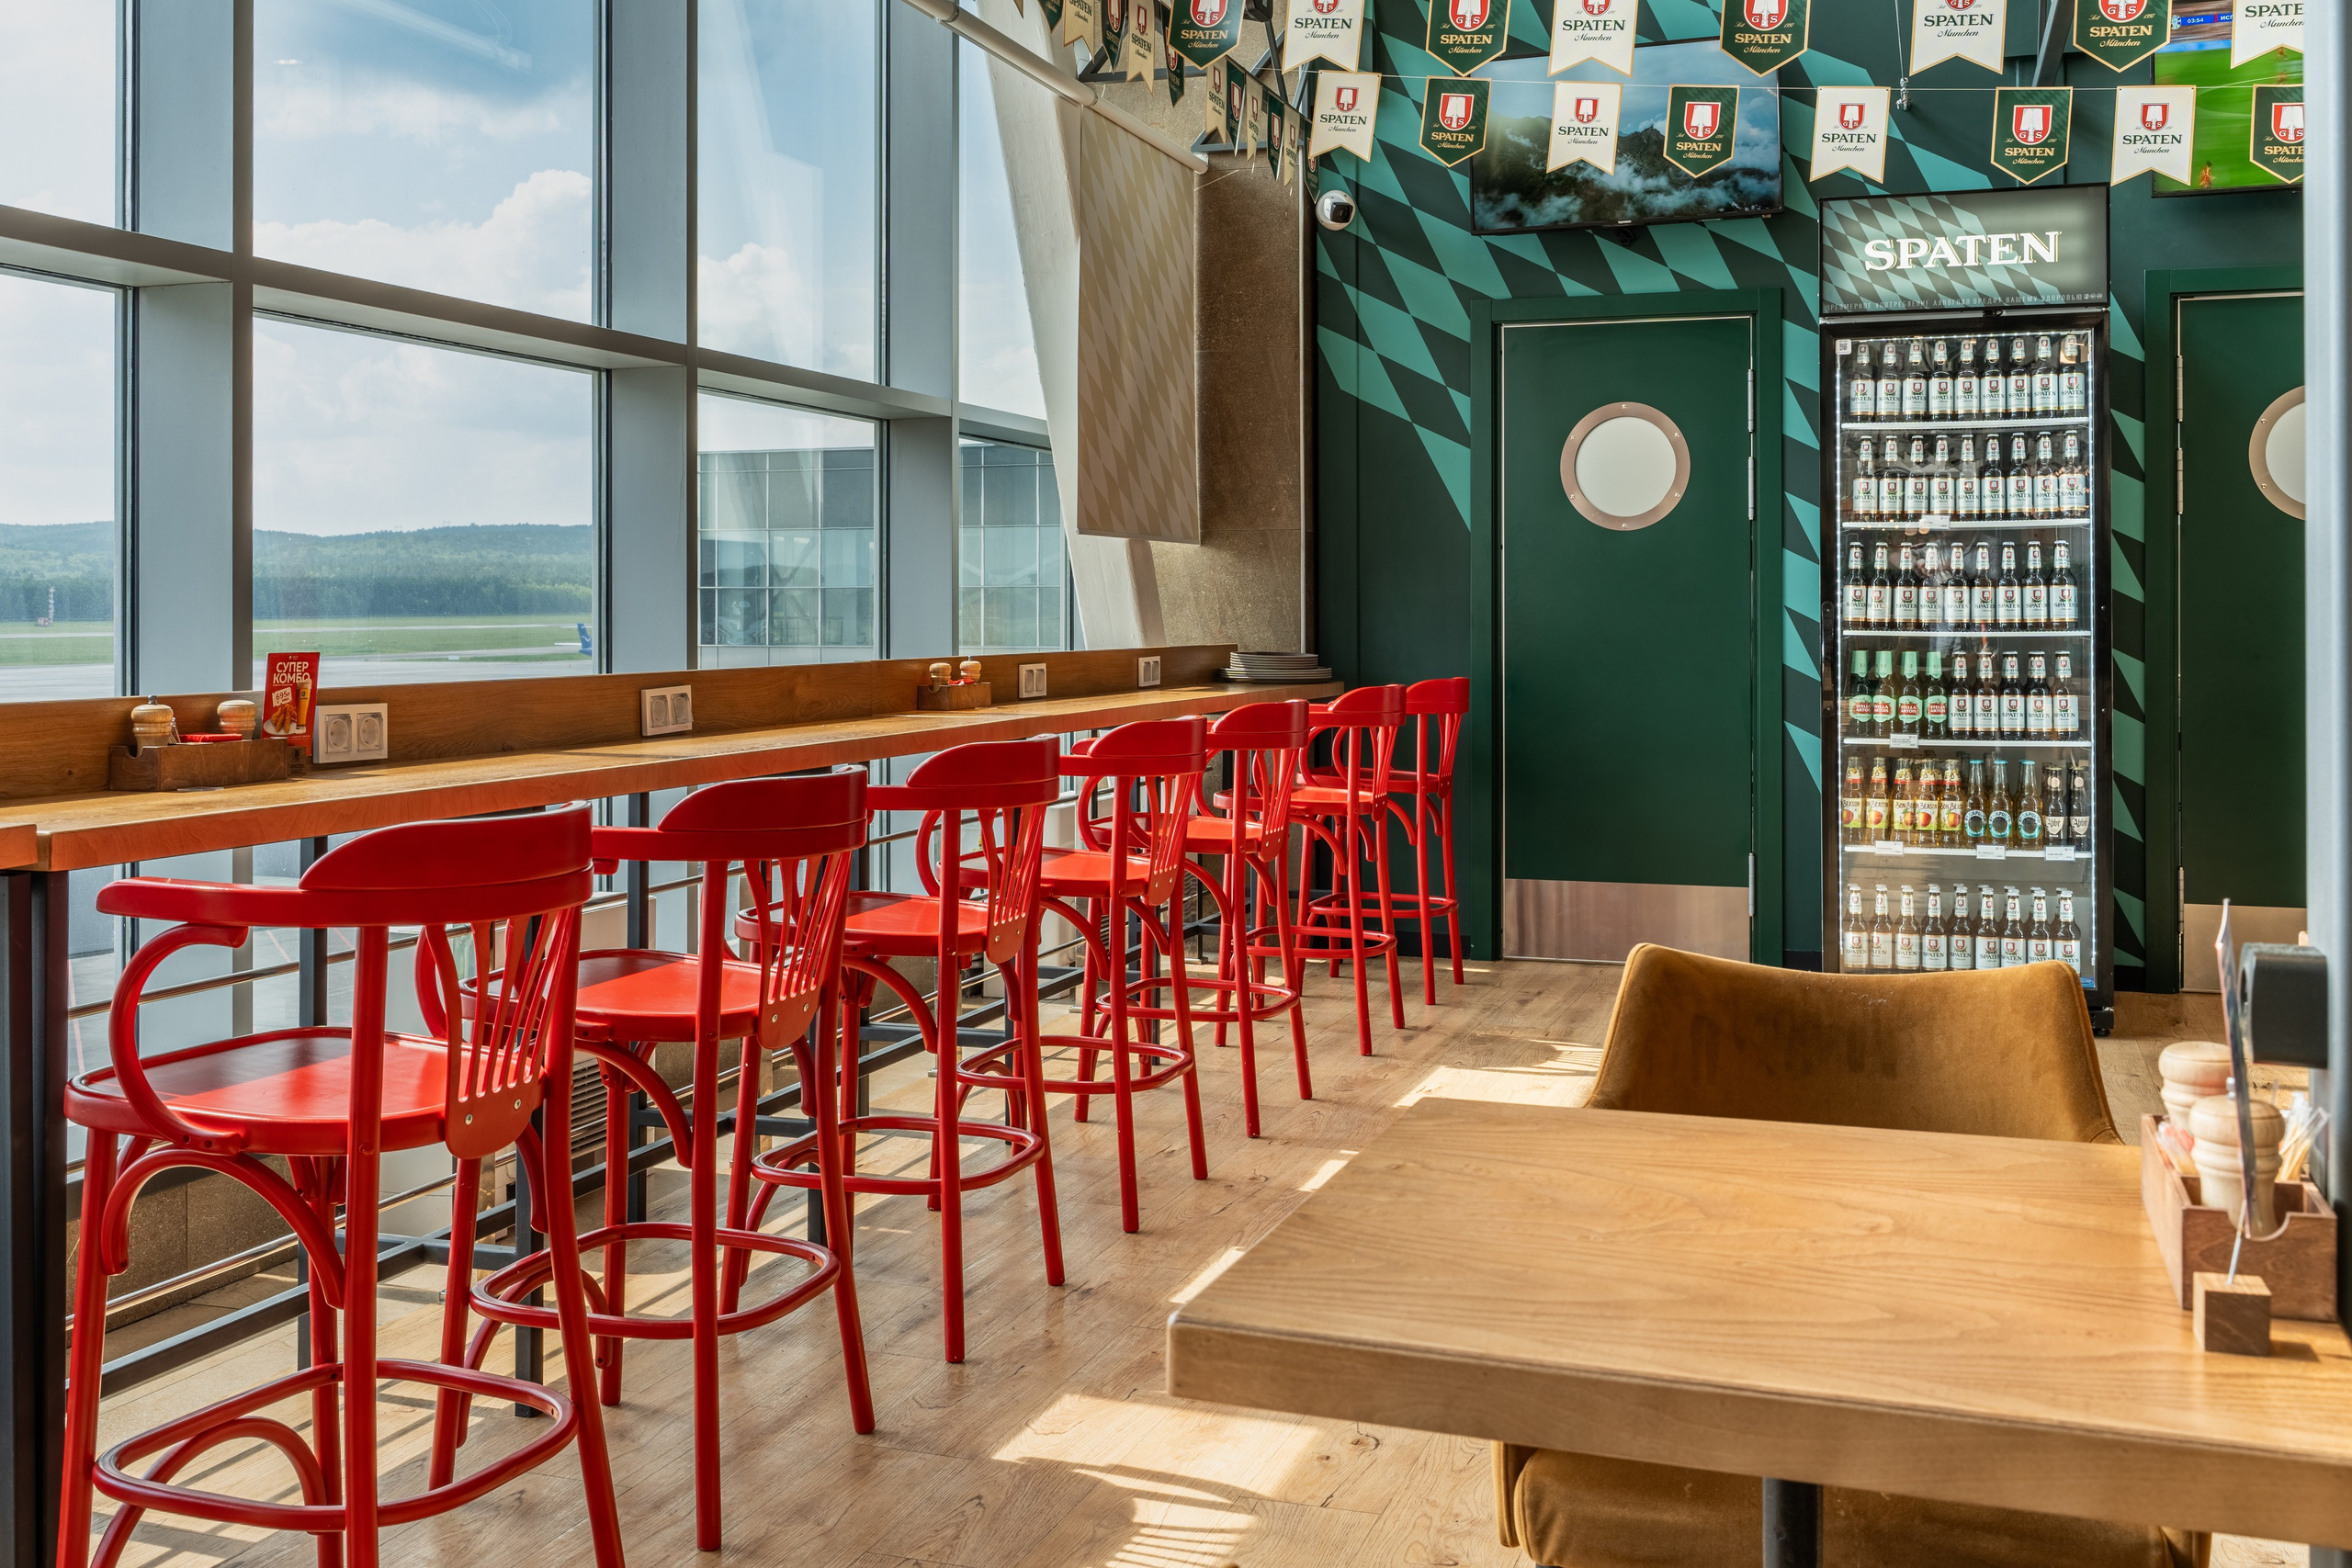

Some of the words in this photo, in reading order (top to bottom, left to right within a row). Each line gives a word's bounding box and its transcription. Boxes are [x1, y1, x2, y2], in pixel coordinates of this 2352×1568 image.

[2245, 3, 2304, 17] SPATE
[1295, 17, 1352, 28] SPATEN
[1563, 20, 1625, 30] SPATEN
[1924, 14, 1994, 27] SPATEN
[1181, 29, 1228, 39] SPATEN
[2090, 25, 2153, 37] SPATEN
[1132, 33, 1151, 53] SPATEN
[1441, 34, 1493, 44] SPATEN
[1735, 33, 1792, 43] SPATEN
[1320, 113, 1367, 125] SPATEN
[1558, 126, 1609, 136] SPATEN
[1431, 132, 1474, 141] SPATEN
[1822, 133, 1876, 143] SPATEN
[2122, 134, 2182, 144] SPATEN
[1676, 142, 1722, 151] SPATEN
[2005, 147, 2055, 156] SPATEN
[2264, 146, 2304, 154] SPATE
[1864, 231, 2062, 271] SPATEN
[1875, 299, 1929, 309] УПОТРЕБЛЕНИЕ
[1933, 298, 1971, 306] АЛКОГОЛЯ
[2041, 293, 2083, 301] ЗДОРОВЬЮ
[276, 661, 309, 672] СУПЕР
[273, 672, 311, 683] КОМБО
